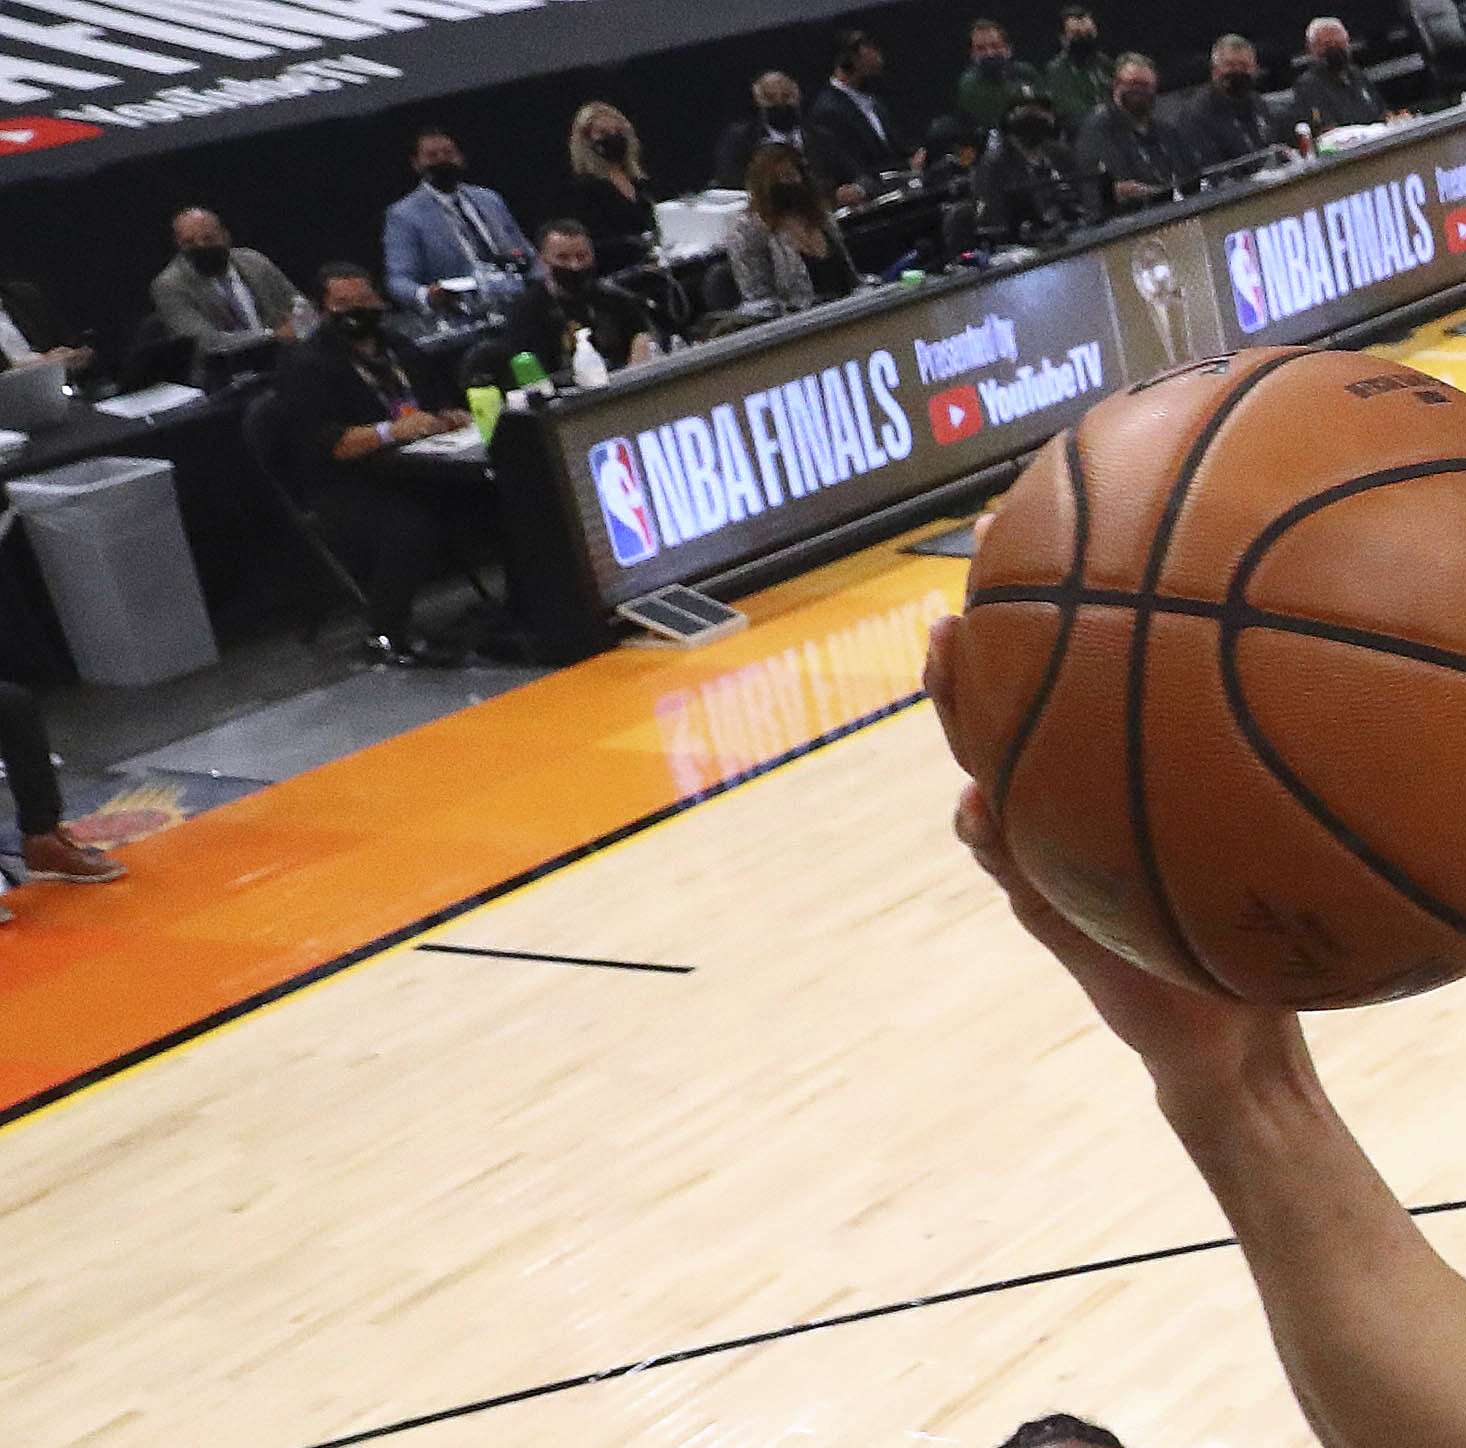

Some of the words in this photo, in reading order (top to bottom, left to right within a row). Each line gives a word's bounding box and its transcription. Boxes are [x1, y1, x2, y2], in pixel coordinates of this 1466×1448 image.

[1255, 208, 1338, 321] NBA
[1323, 173, 1434, 296] FINALS
[637, 402, 763, 547] NBA
[743, 348, 914, 507] FINALS
